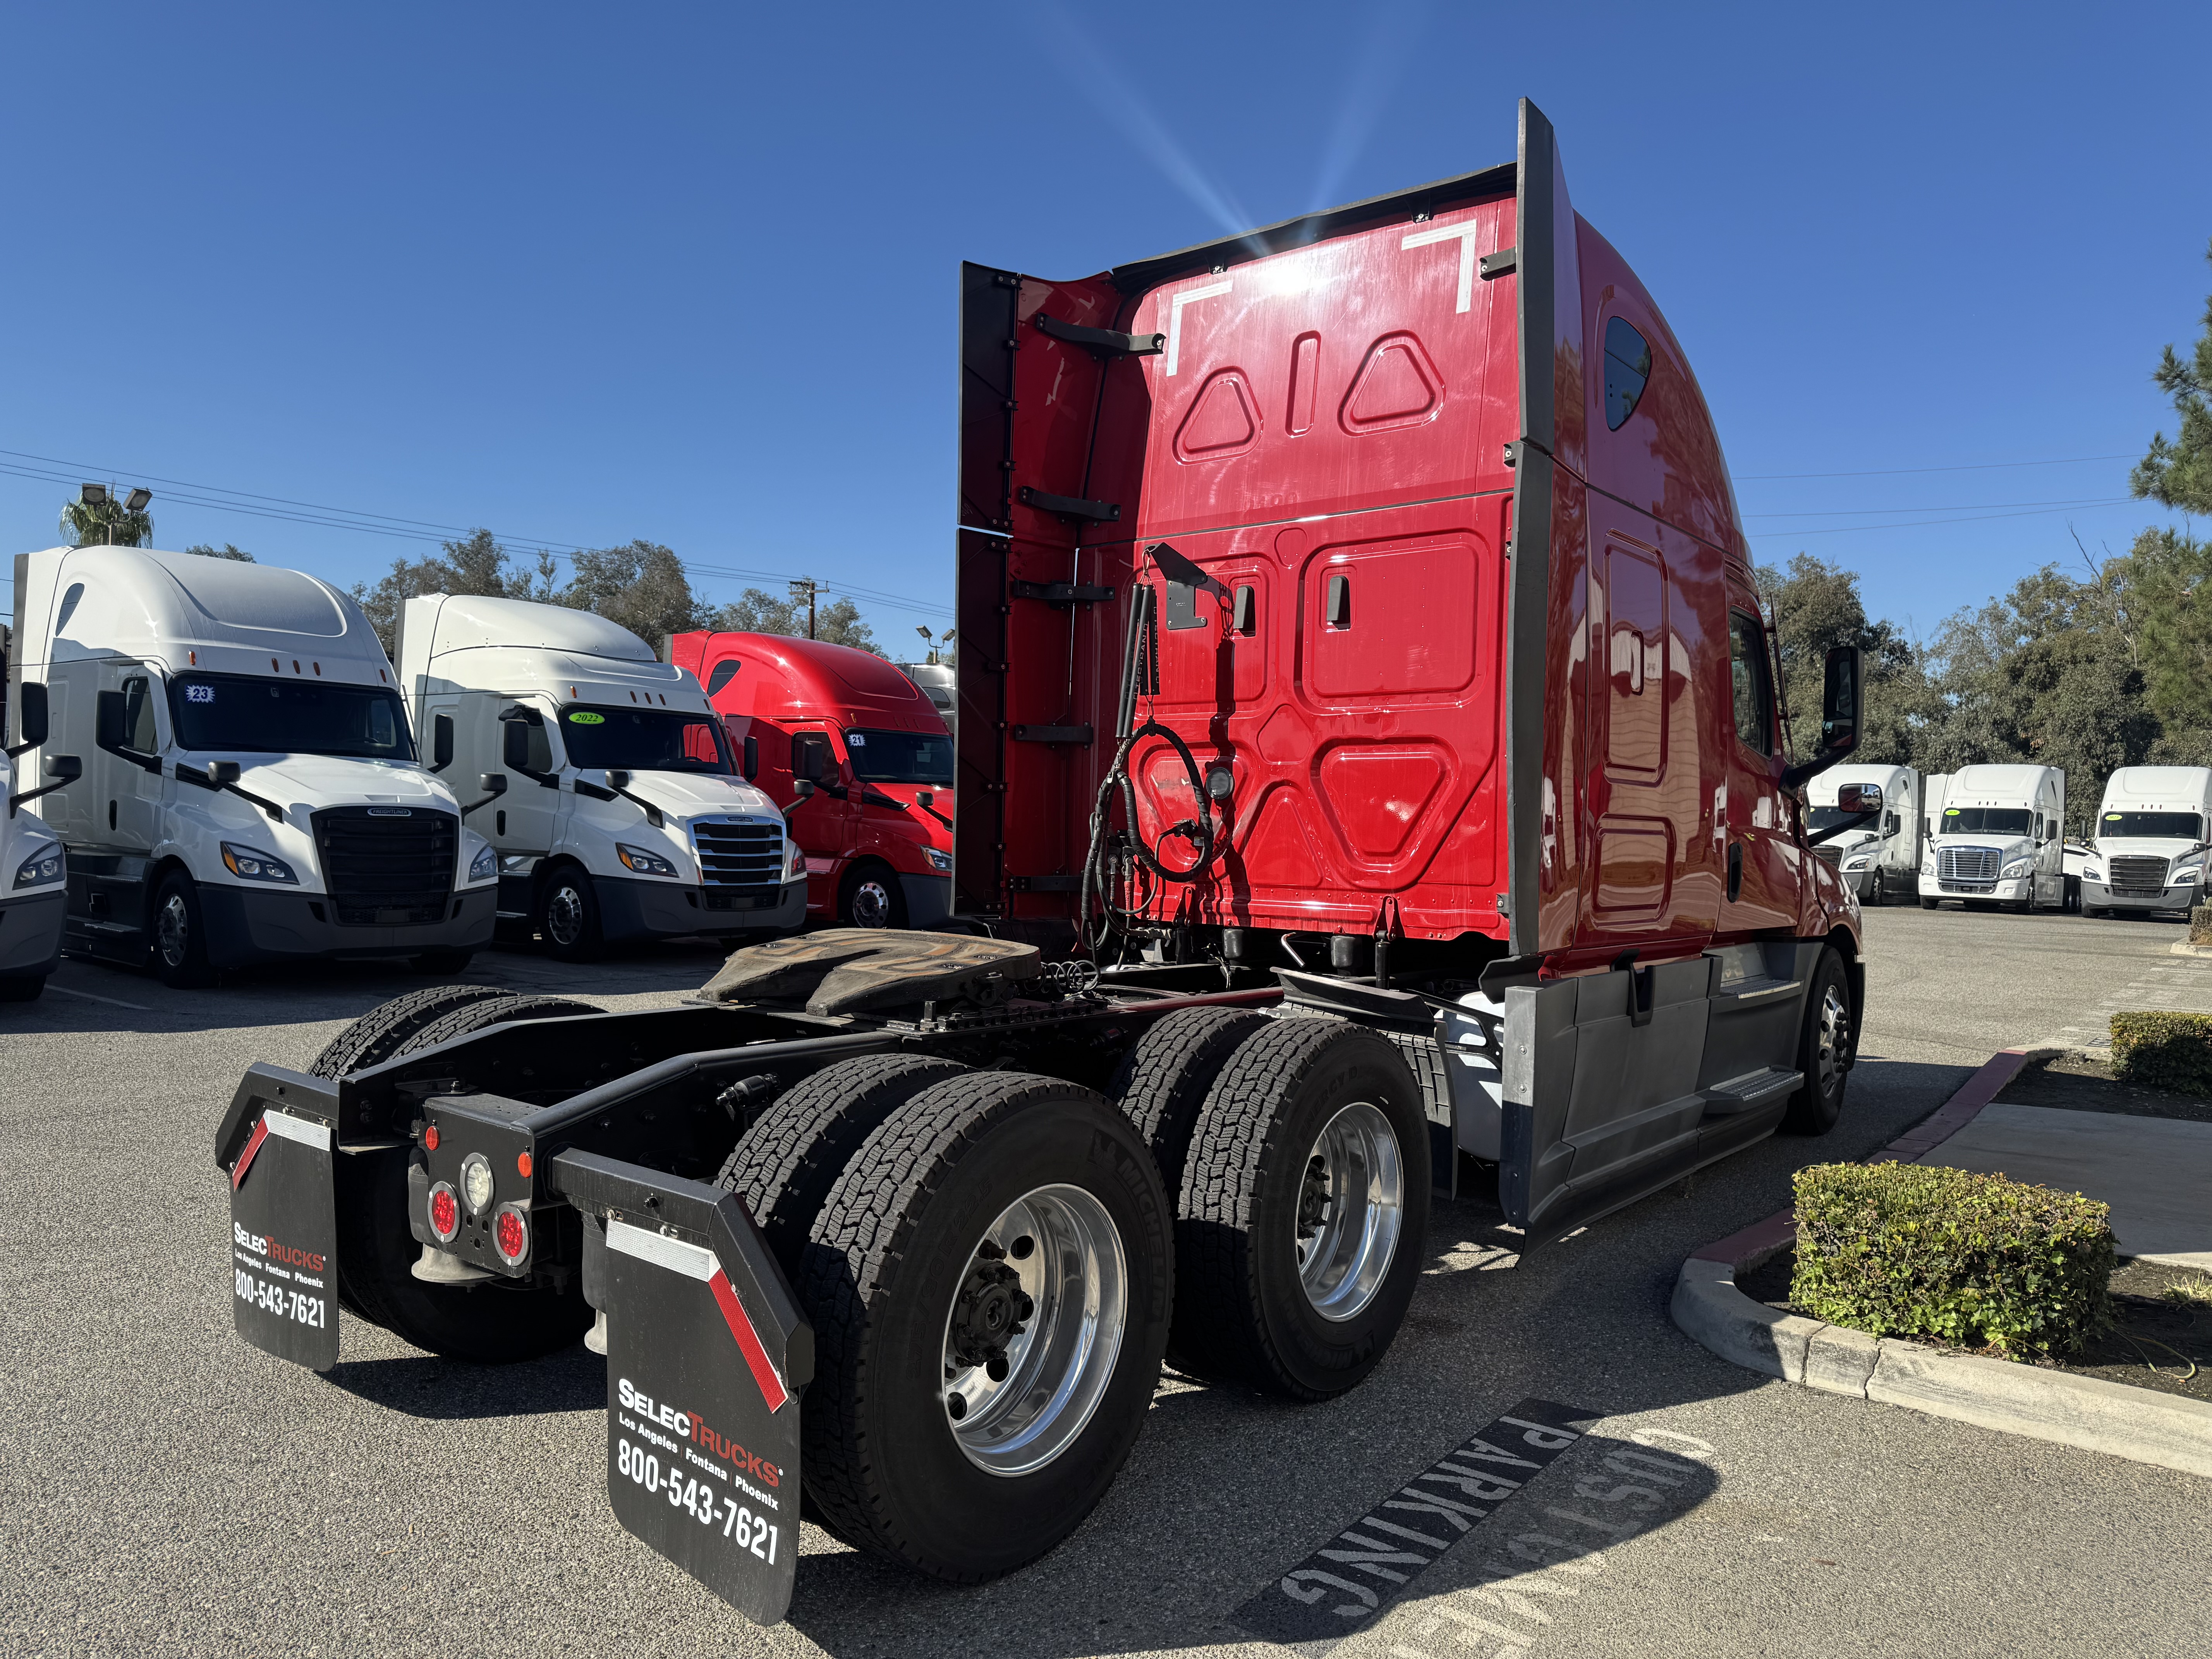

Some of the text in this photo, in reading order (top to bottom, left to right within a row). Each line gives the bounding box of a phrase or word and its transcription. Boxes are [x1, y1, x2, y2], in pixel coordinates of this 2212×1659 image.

[192, 688, 208, 699] 23
[243, 1253, 262, 1269] Angeles
[266, 1262, 290, 1279] Fontana
[295, 1272, 323, 1288] Phoenix
[1117, 1156, 1166, 1317] MICHELIN
[235, 1268, 325, 1328] 800-543-7621
[618, 1438, 778, 1565] 800-543-7621
[619, 1412, 778, 1511] Los Angeles Fontana Phoenix
[1281, 1415, 1580, 1617] PARKING
